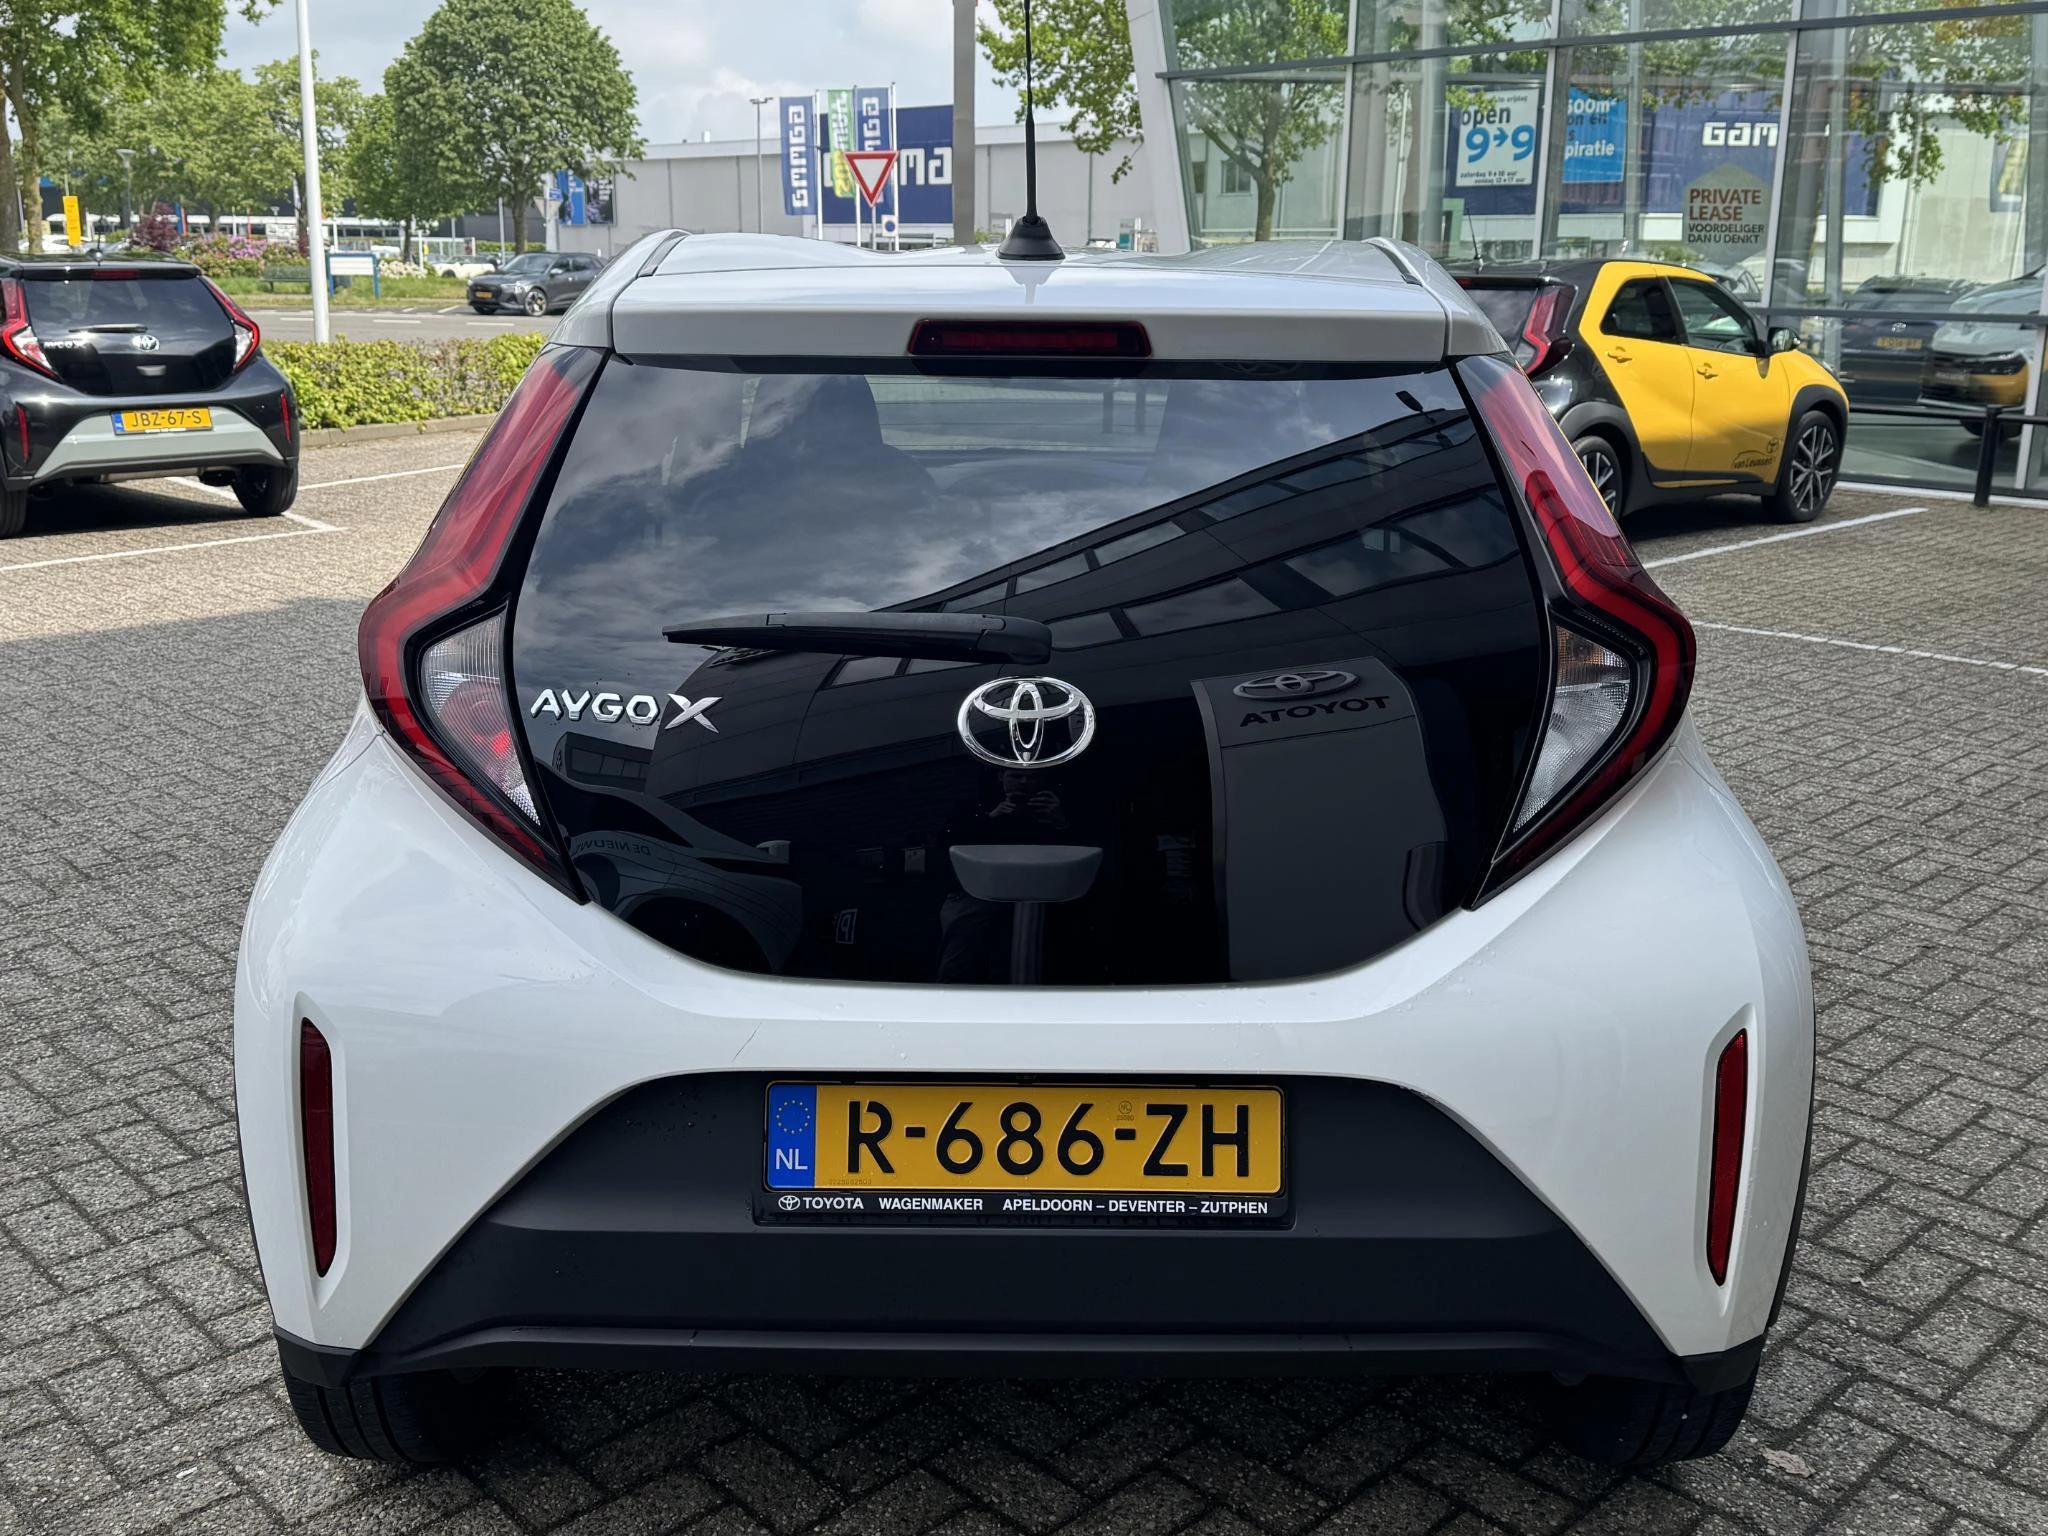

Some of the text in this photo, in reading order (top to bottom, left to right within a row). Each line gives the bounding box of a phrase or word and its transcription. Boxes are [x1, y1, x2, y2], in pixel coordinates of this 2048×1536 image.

[1462, 107, 1511, 129] open
[1689, 188, 1762, 205] PRIVATE
[1689, 206, 1743, 221] LEASE
[1688, 223, 1765, 233] VOORDELIGER
[1688, 234, 1760, 244] DAN U DENKT
[131, 410, 202, 428] JBZ-67-S
[530, 688, 661, 725] AYGO
[847, 1100, 1250, 1177] R-686-ZH
[775, 1149, 808, 1170] NL
[803, 1197, 865, 1210] TOYOTA
[879, 1198, 983, 1211] WAGENMAKER
[1003, 1198, 1093, 1212] APELDOORN
[1109, 1199, 1186, 1213] DEVENTER
[1201, 1201, 1268, 1214] ZUTPHEN
